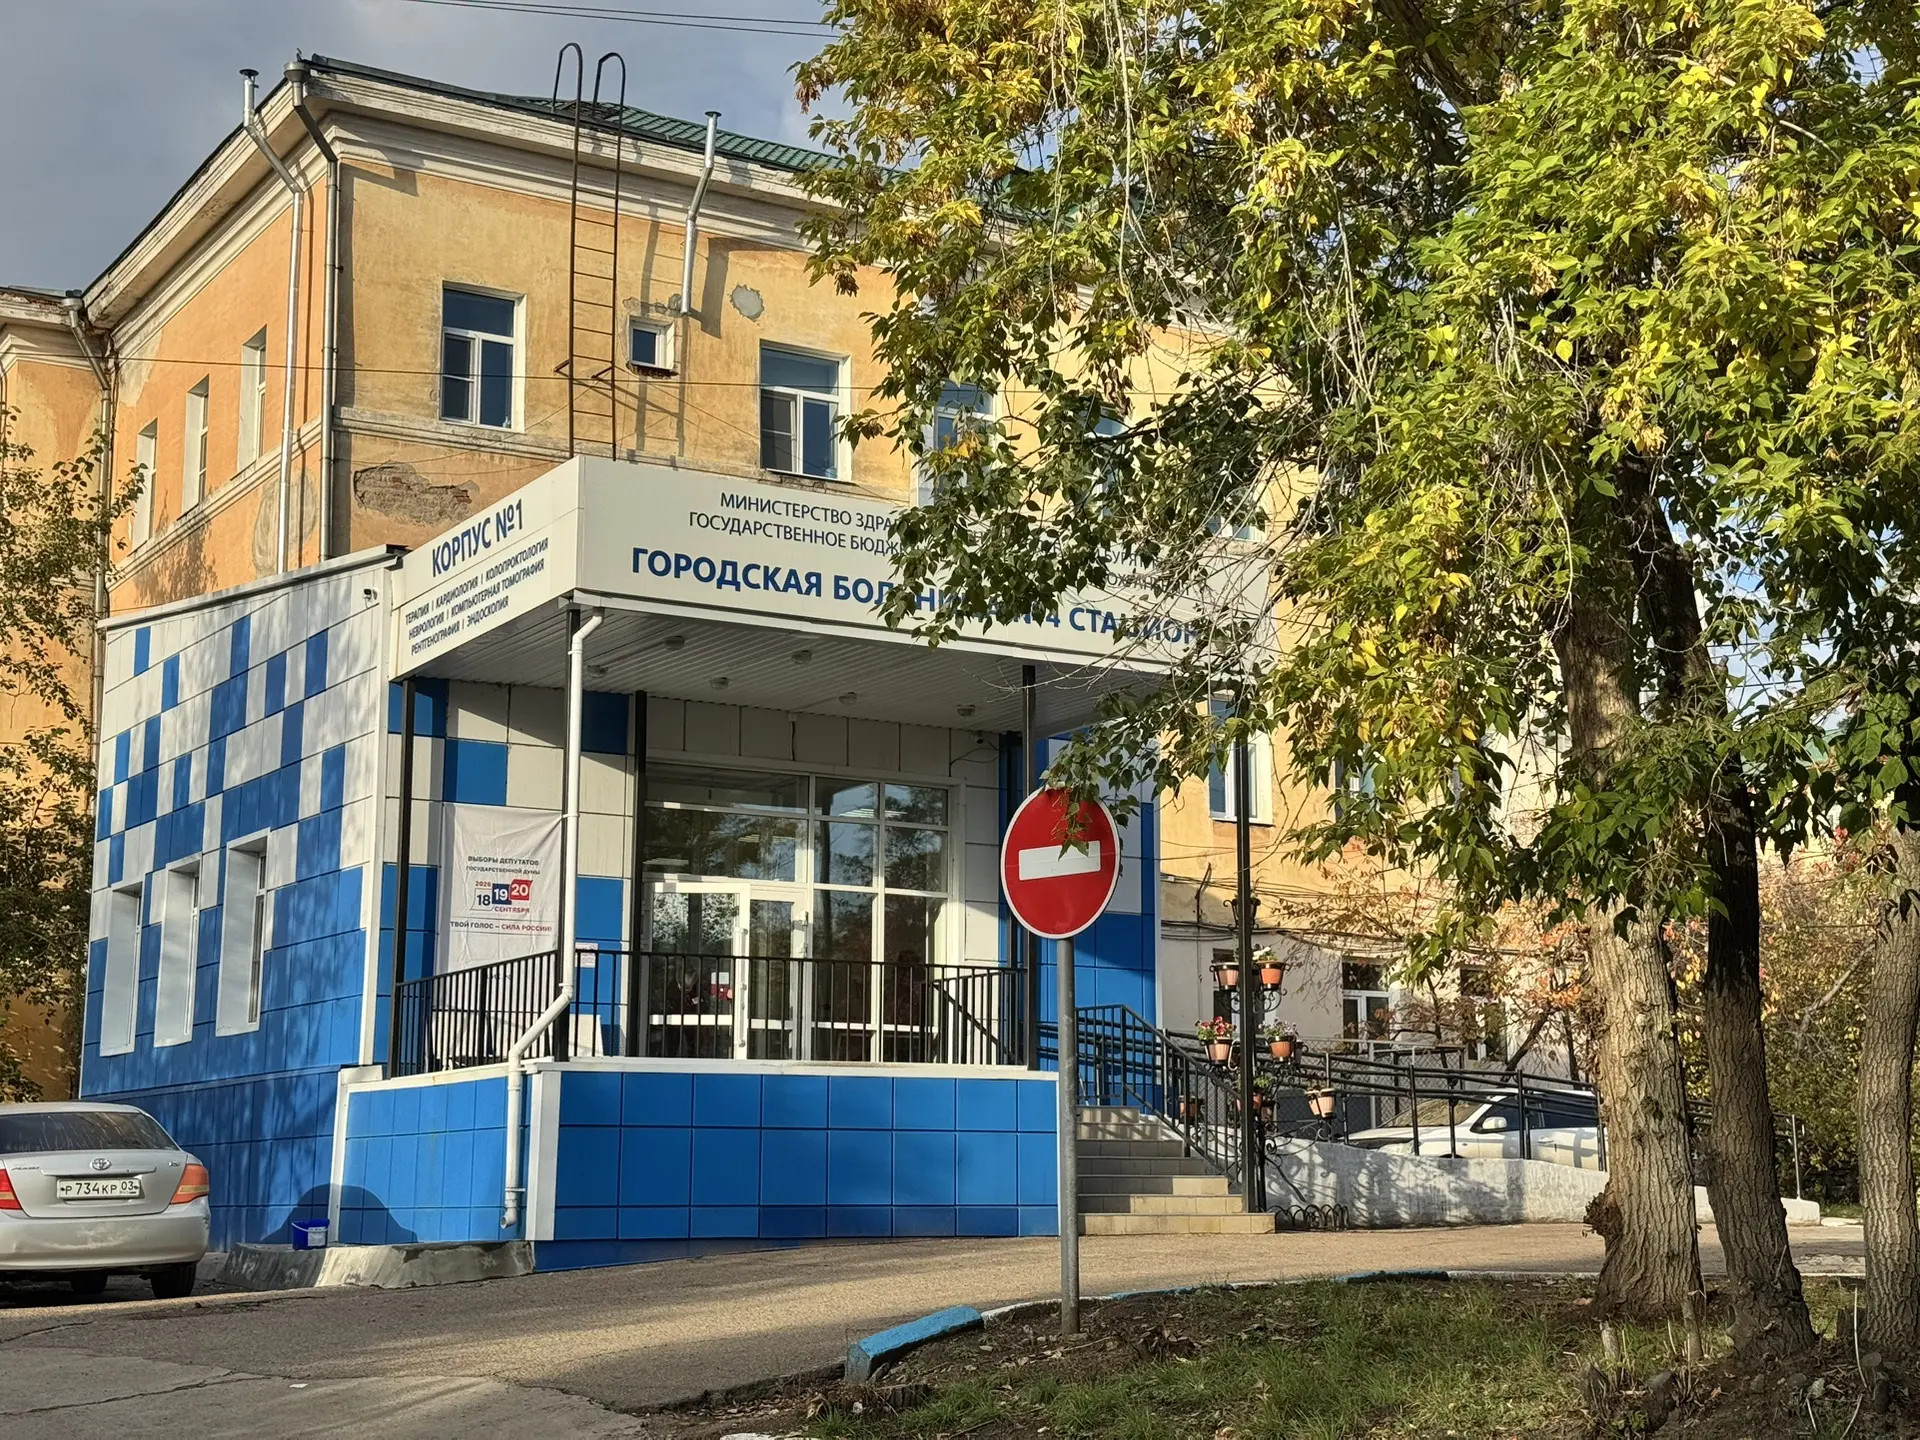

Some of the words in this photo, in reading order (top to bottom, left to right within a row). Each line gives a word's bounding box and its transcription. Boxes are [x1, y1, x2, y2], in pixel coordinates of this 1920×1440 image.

[720, 492, 852, 526] МИНИСТЕРСТВО
[432, 517, 492, 578] КОРПУС
[496, 498, 523, 543] №1
[689, 511, 847, 549] ГОСУДАРСТВЕННОЕ
[405, 602, 430, 626] ТЕРАПИЯ
[435, 576, 479, 609] КАРДИОЛОГИЯ
[485, 537, 549, 581] КОЛОПРОКТОЛОГИЯ
[632, 547, 822, 598] ГОРОДСКАЯ
[408, 609, 445, 640] НЕВРОЛОГИЯ
[451, 581, 501, 617] КОМПЬЮТЕРНАЯ
[501, 558, 545, 592] ТОМОГРАФИЯ
[410, 620, 460, 656] РЕНТГЕНОГРАФИЯ
[466, 595, 509, 627] ЭНДОСКОПИЯ
[466, 865, 522, 875] ГОСУДАРСТВЕННОЙ
[523, 868, 541, 876] ДУМЫ
[468, 855, 499, 863] ВЫБОРЫ
[500, 858, 540, 866] ДЕПУТАТОВ
[476, 894, 491, 906] 18
[493, 888, 508, 901] 19
[511, 884, 529, 897] 20
[494, 906, 530, 914] СЕНТЯБРЯ
[450, 920, 470, 928] ТВОЙ
[121, 1181, 134, 1191] 03
